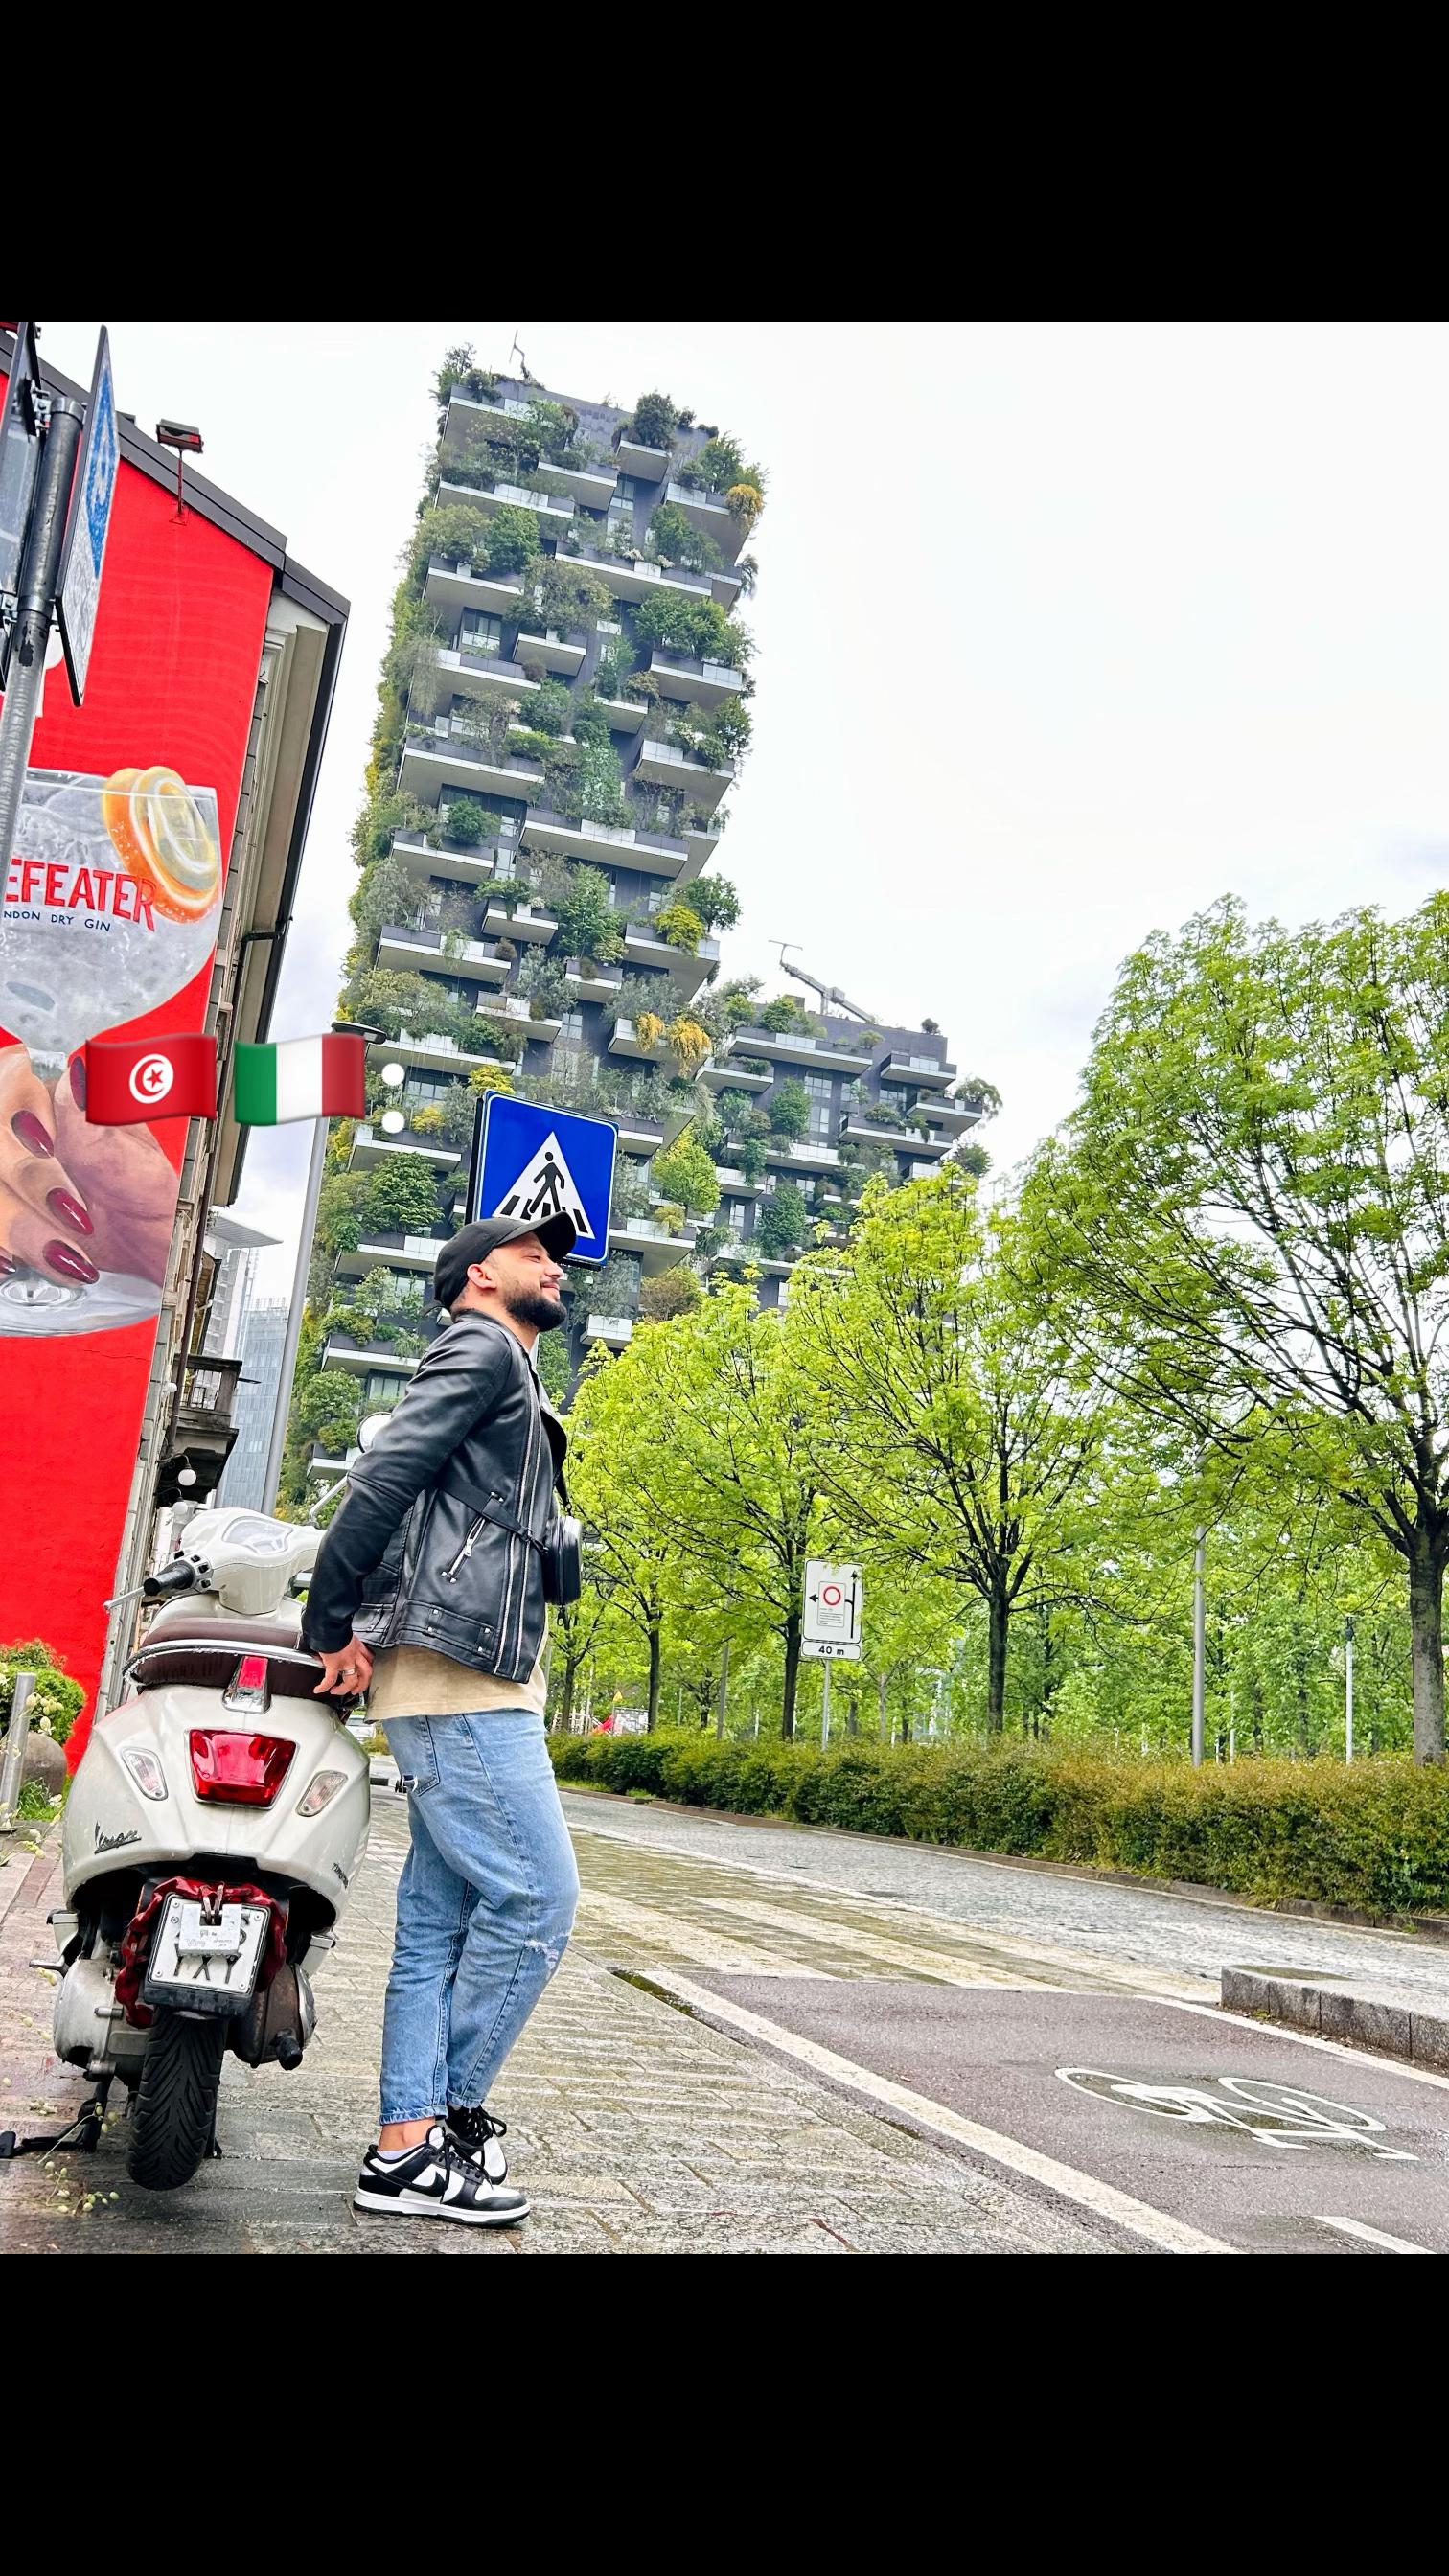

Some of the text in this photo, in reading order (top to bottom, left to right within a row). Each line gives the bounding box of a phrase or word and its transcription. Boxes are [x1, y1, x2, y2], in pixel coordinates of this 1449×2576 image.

[51, 914, 75, 925] DRY
[84, 918, 111, 932] GIN
[818, 1645, 844, 1656] 40 m
